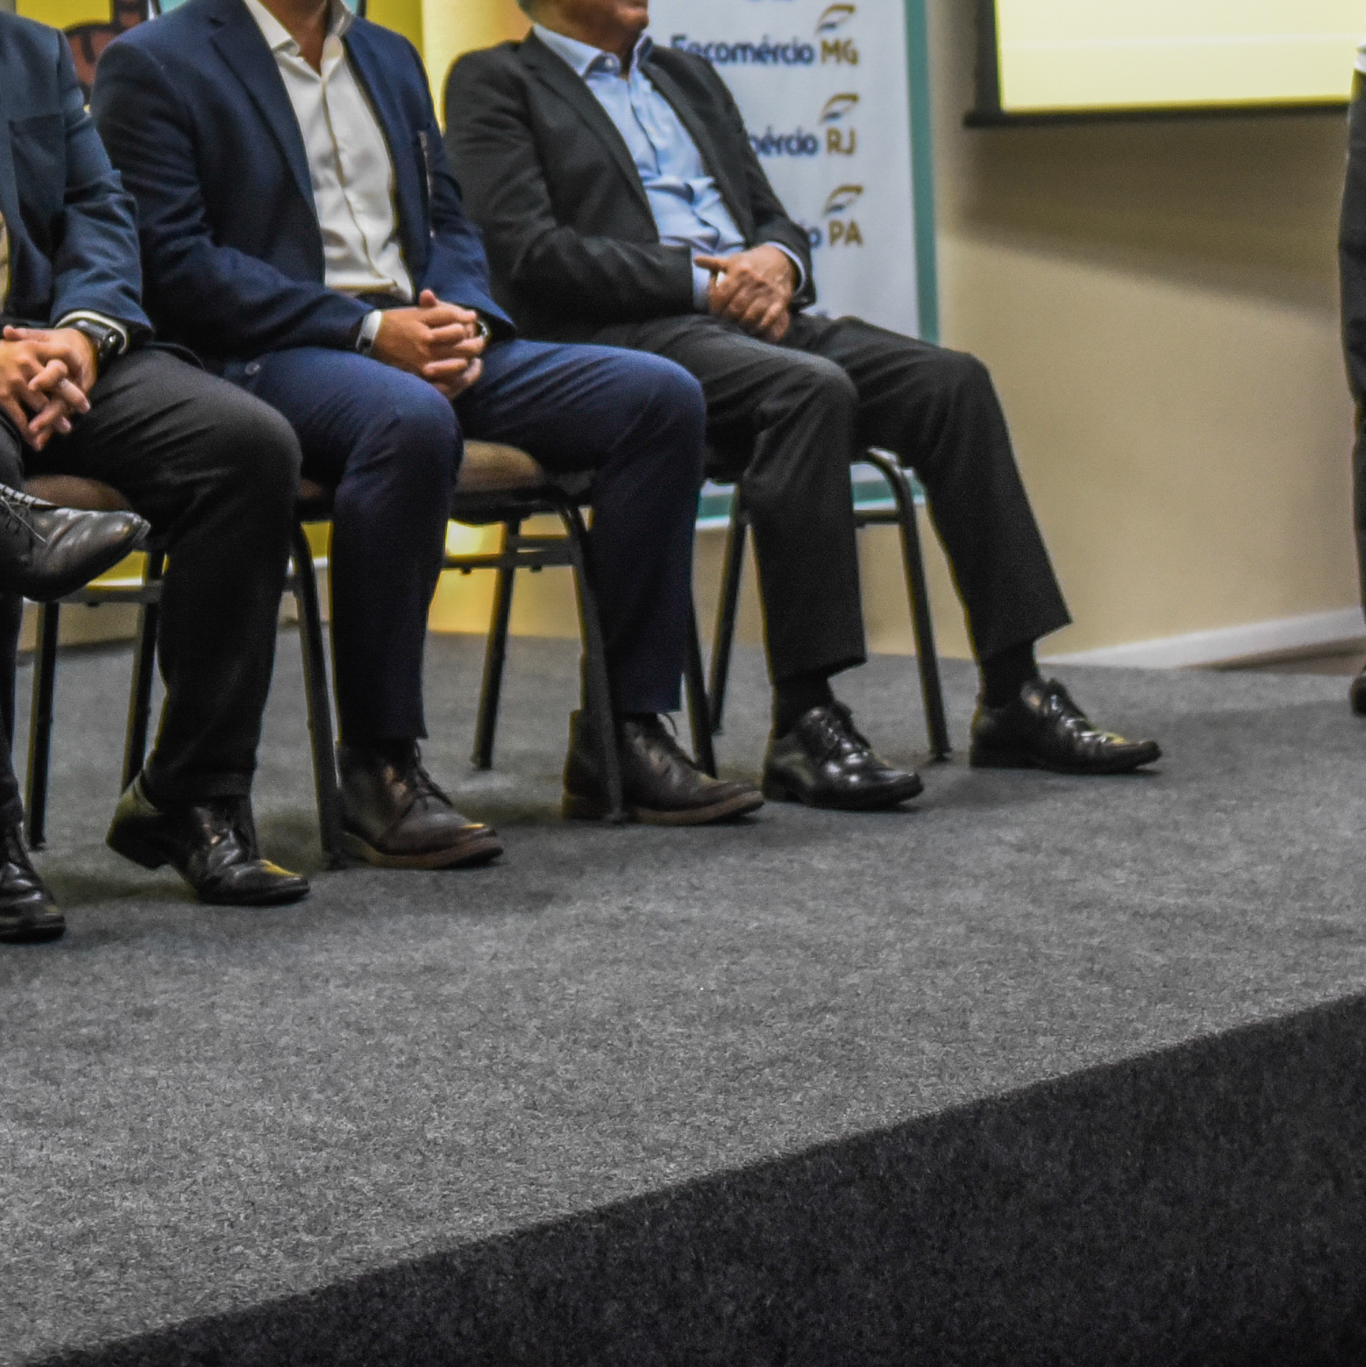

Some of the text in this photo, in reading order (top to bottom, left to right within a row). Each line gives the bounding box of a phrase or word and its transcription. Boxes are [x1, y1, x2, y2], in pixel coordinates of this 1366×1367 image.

[821, 38, 858, 65] MG
[826, 127, 857, 156] RJ
[828, 219, 863, 249] PA
